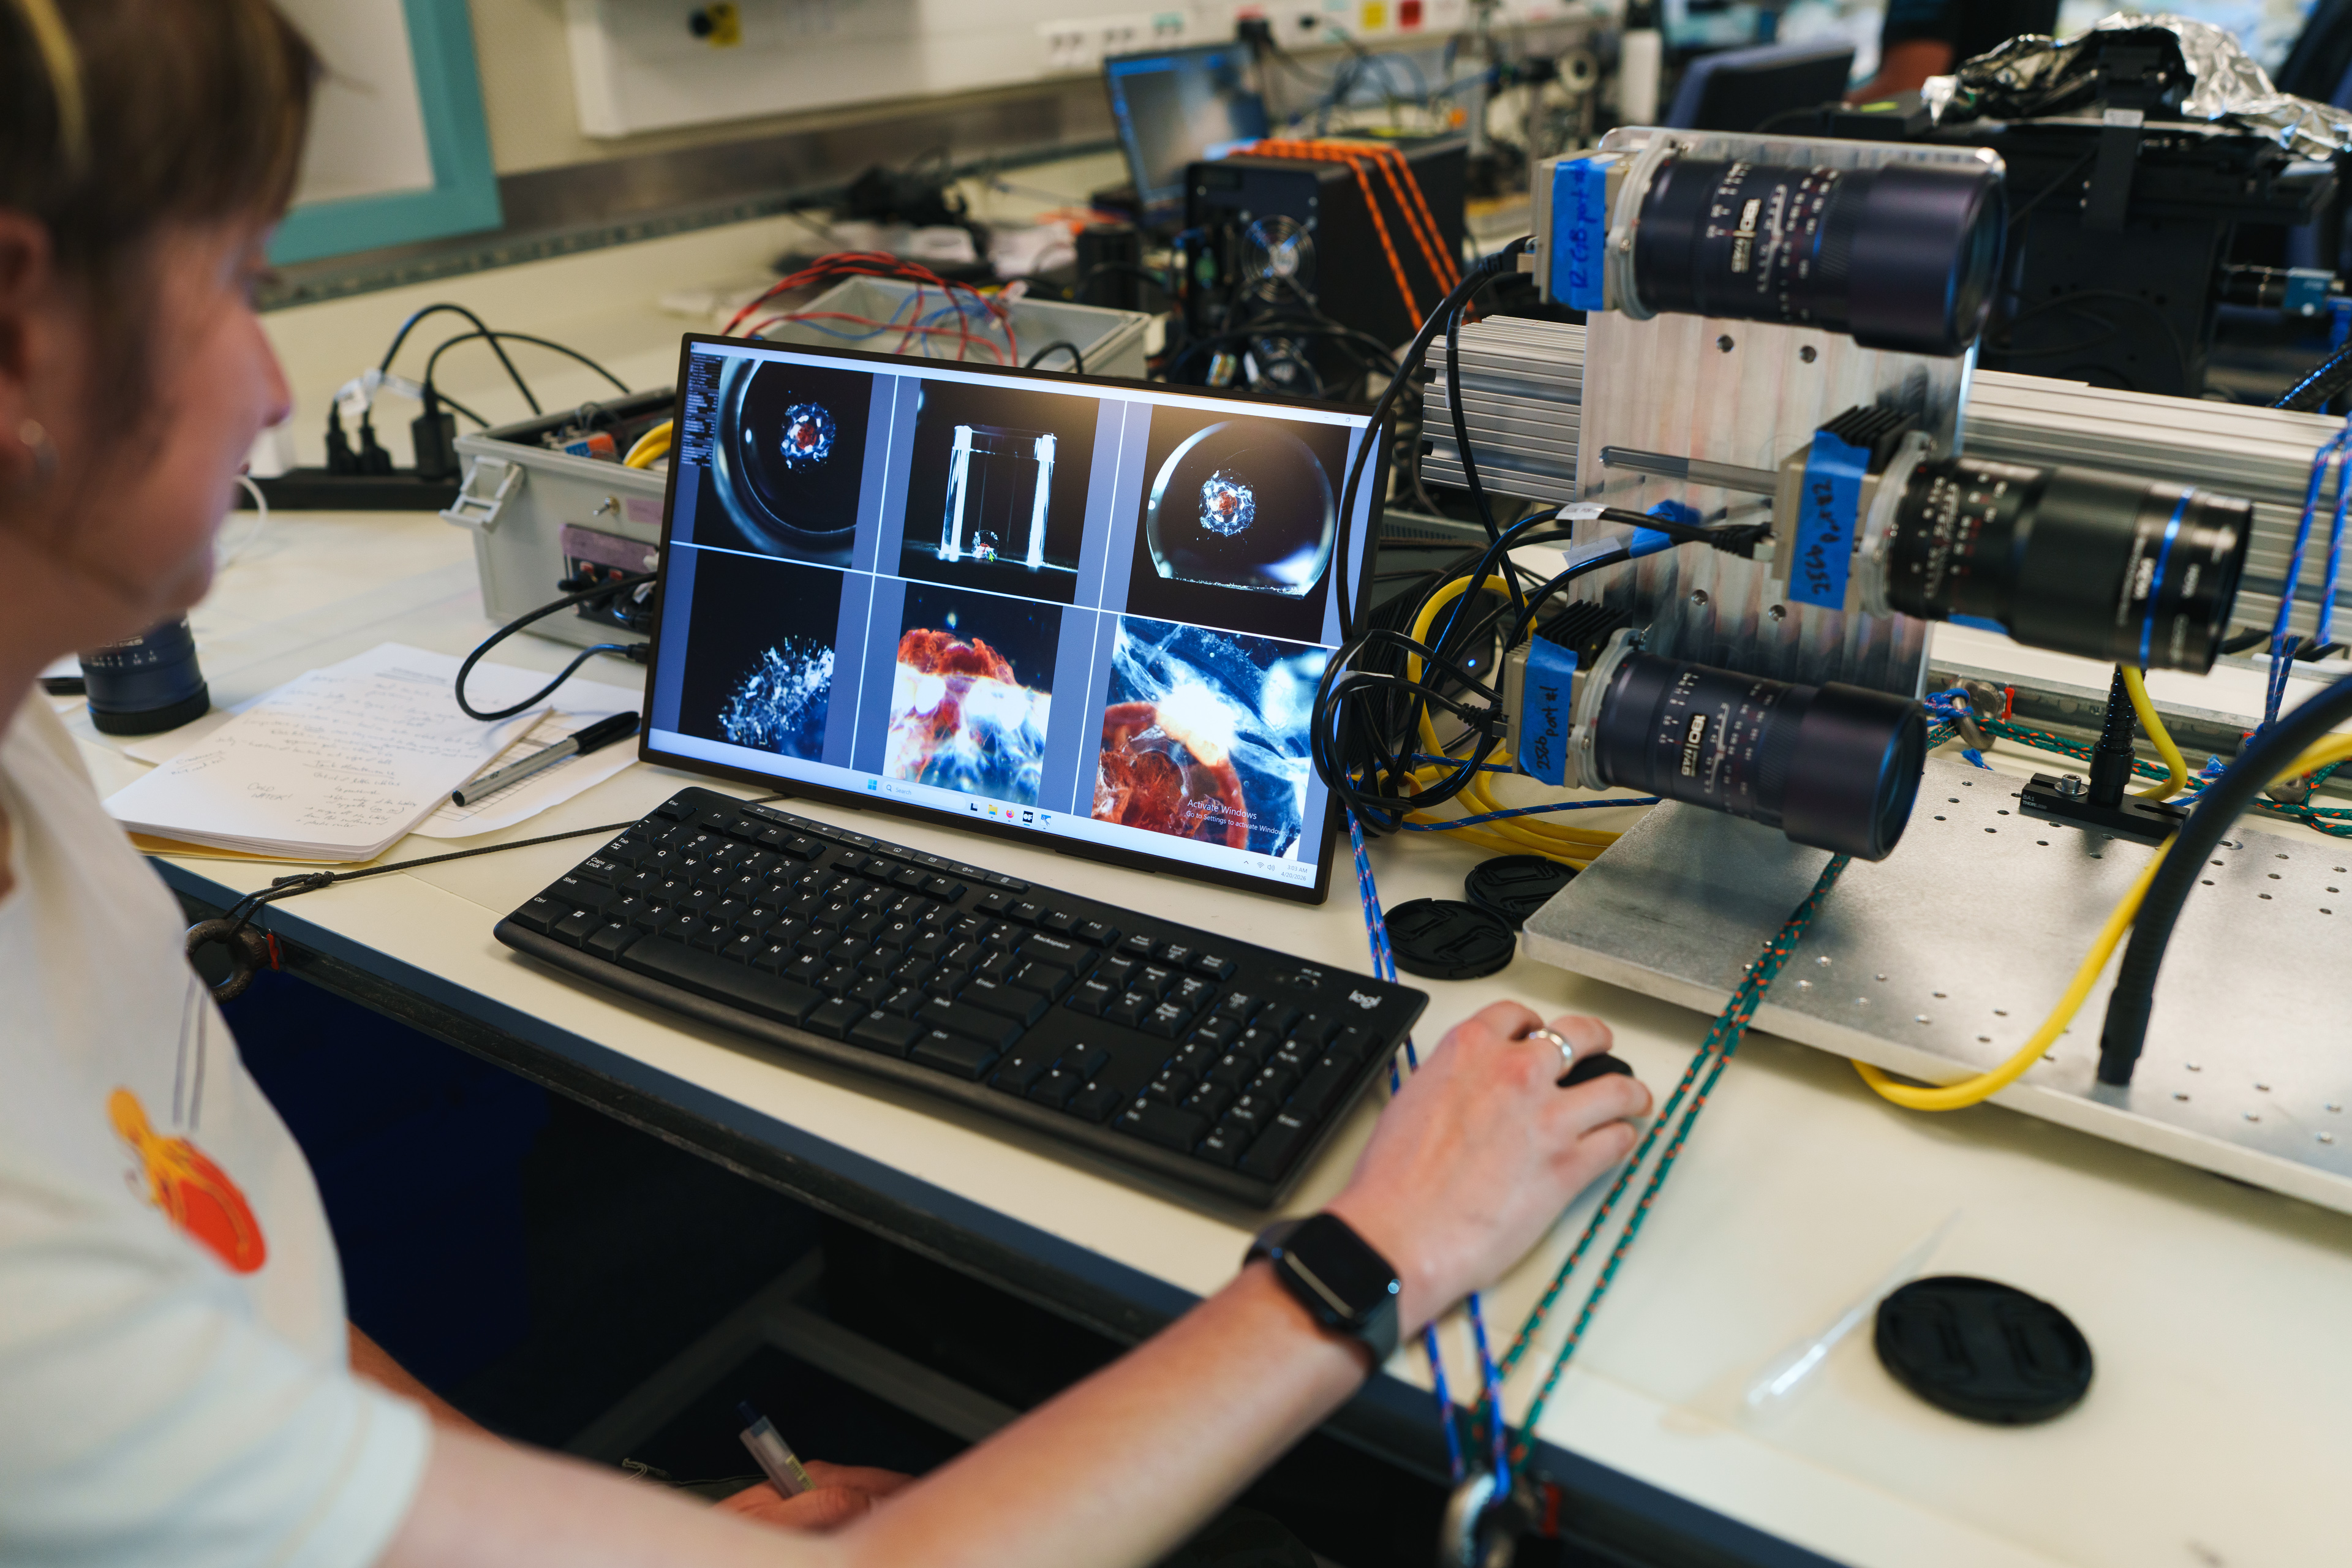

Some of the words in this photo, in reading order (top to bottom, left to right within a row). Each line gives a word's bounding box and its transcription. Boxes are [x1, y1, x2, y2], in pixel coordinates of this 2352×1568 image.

[1539, 685, 1558, 701] #1
[1541, 706, 1559, 737] port
[1688, 715, 1706, 744] 180
[895, 786, 911, 796] Search
[1187, 799, 1219, 812] Activate
[1221, 805, 1257, 820] Windows
[1203, 813, 1226, 825] Settings
[1235, 821, 1258, 830] activate
[1259, 825, 1287, 836] Windows.
[1281, 871, 1306, 881] 4/20/2026
[1033, 933, 1071, 949] Backspace
[801, 955, 813, 963] M
[975, 978, 997, 989] Enter
[1348, 989, 1382, 1009] logi
